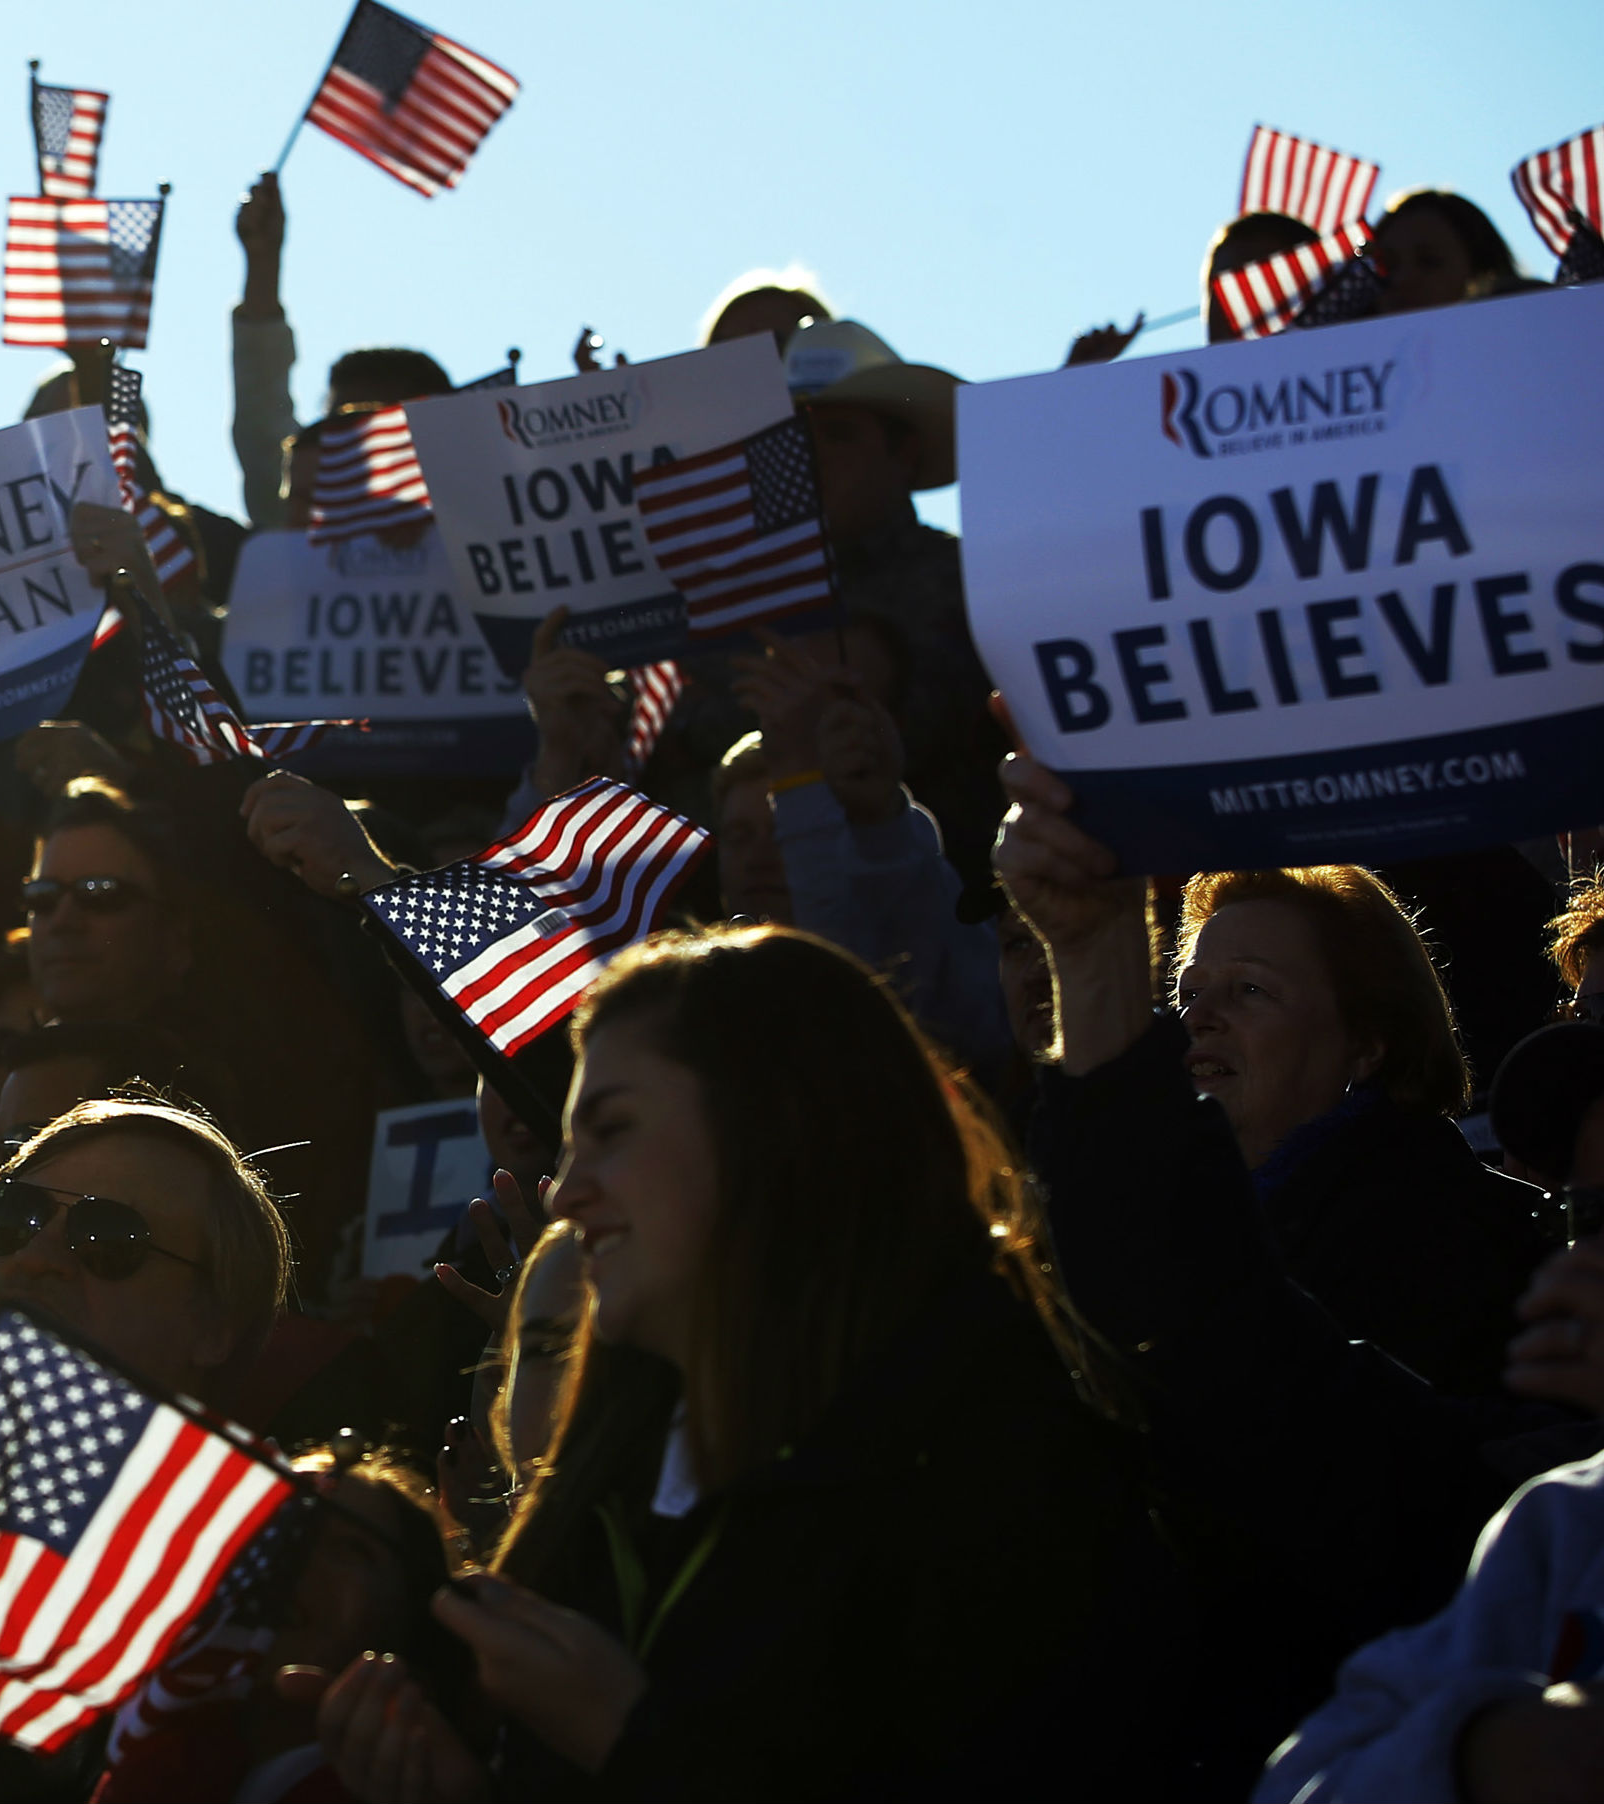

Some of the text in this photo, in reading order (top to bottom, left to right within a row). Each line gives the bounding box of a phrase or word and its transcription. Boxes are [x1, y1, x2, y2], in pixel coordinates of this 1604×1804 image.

[498, 391, 628, 448] ROMNEY
[1161, 361, 1396, 459] ROMNEY
[1139, 463, 1473, 602] IOWA
[306, 592, 461, 641] IOWA
[1208, 748, 1527, 816] MITTROMNEY.COM
